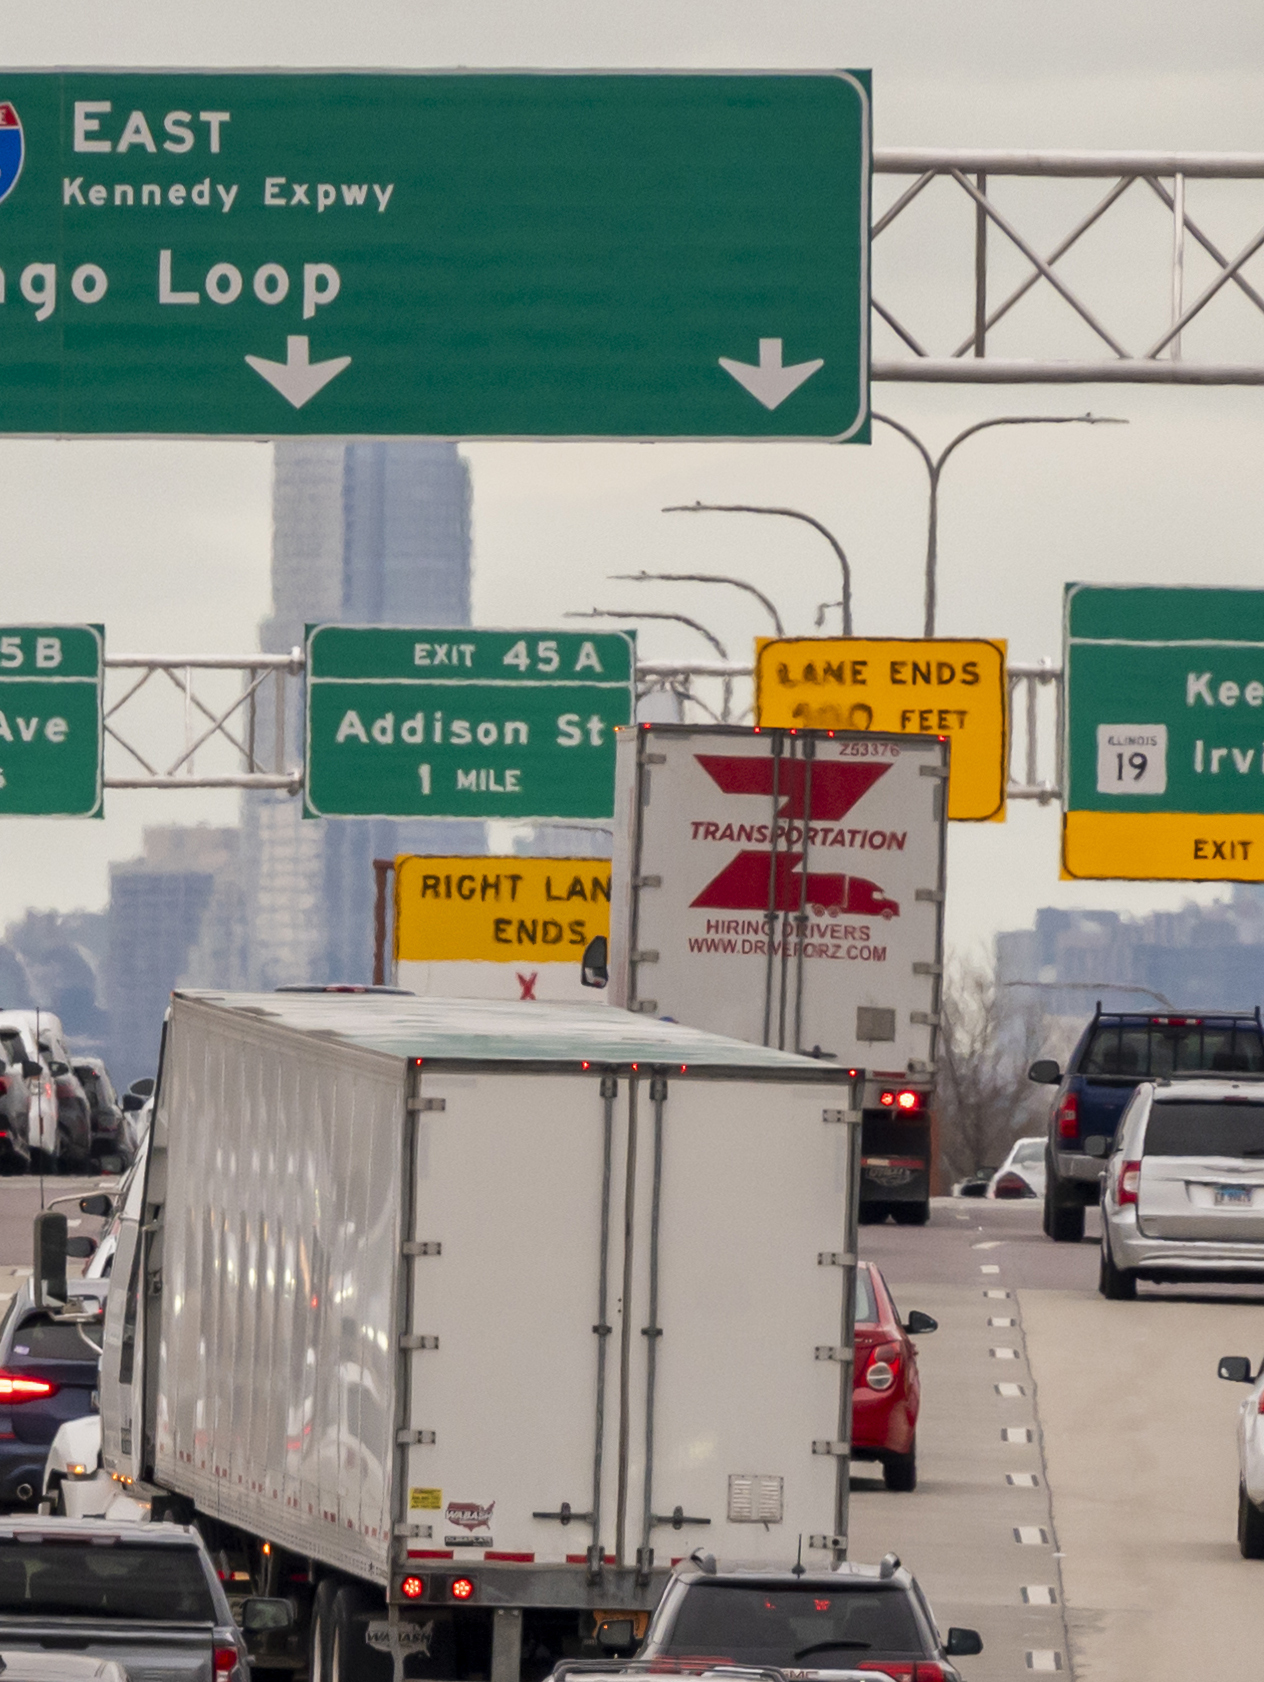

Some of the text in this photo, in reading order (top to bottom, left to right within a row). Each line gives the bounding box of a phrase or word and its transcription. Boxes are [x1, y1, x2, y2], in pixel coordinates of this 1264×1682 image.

[73, 101, 230, 153] EAST
[62, 176, 395, 213] Kennedy Expwy
[158, 249, 341, 319] Loop
[413, 642, 476, 667] EXIT
[889, 660, 980, 686] ENDS
[1186, 671, 1264, 707] Kee
[336, 709, 606, 748] Addison St
[900, 708, 968, 731] FEET
[839, 743, 901, 758] Z53376
[1107, 735, 1157, 747] ILLINOIS
[1115, 751, 1148, 782] 19
[1193, 739, 1264, 774] Irv
[417, 763, 522, 795] 1 MILE
[690, 820, 908, 851] TRANSPORTATION
[1193, 838, 1254, 861] EXIT
[420, 873, 523, 902] RIGHT
[493, 917, 586, 946] ENDS
[783, 919, 871, 942] DRIVERS
[688, 937, 888, 962] WWW.DRVEFORZ.COM
[367, 1631, 432, 1643] WAASH
